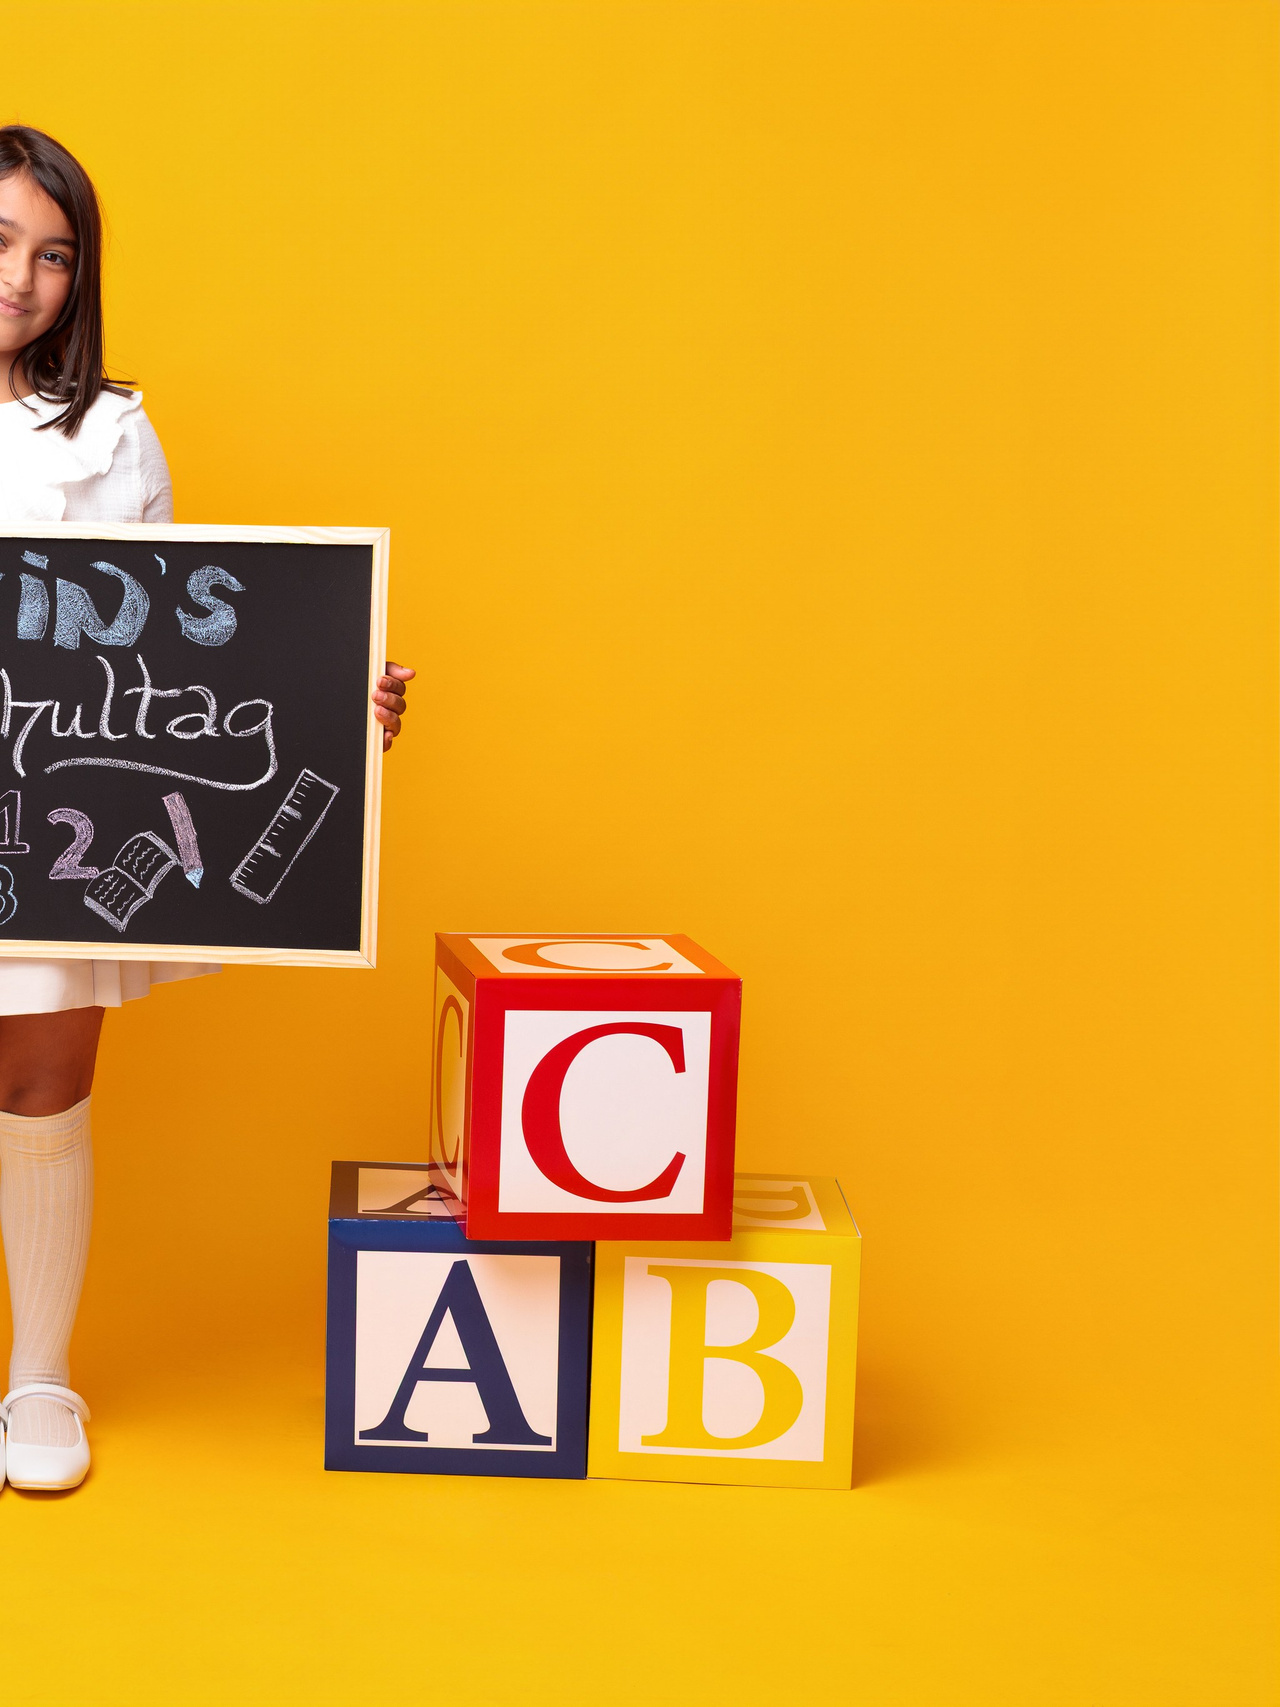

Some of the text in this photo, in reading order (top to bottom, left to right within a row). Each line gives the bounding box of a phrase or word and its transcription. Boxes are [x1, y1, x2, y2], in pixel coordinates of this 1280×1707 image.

[46, 807, 101, 881] 2
[501, 940, 674, 972] C
[436, 994, 464, 1179] C
[521, 1021, 687, 1203] C
[358, 1259, 553, 1446] A
[640, 1264, 804, 1451] B
